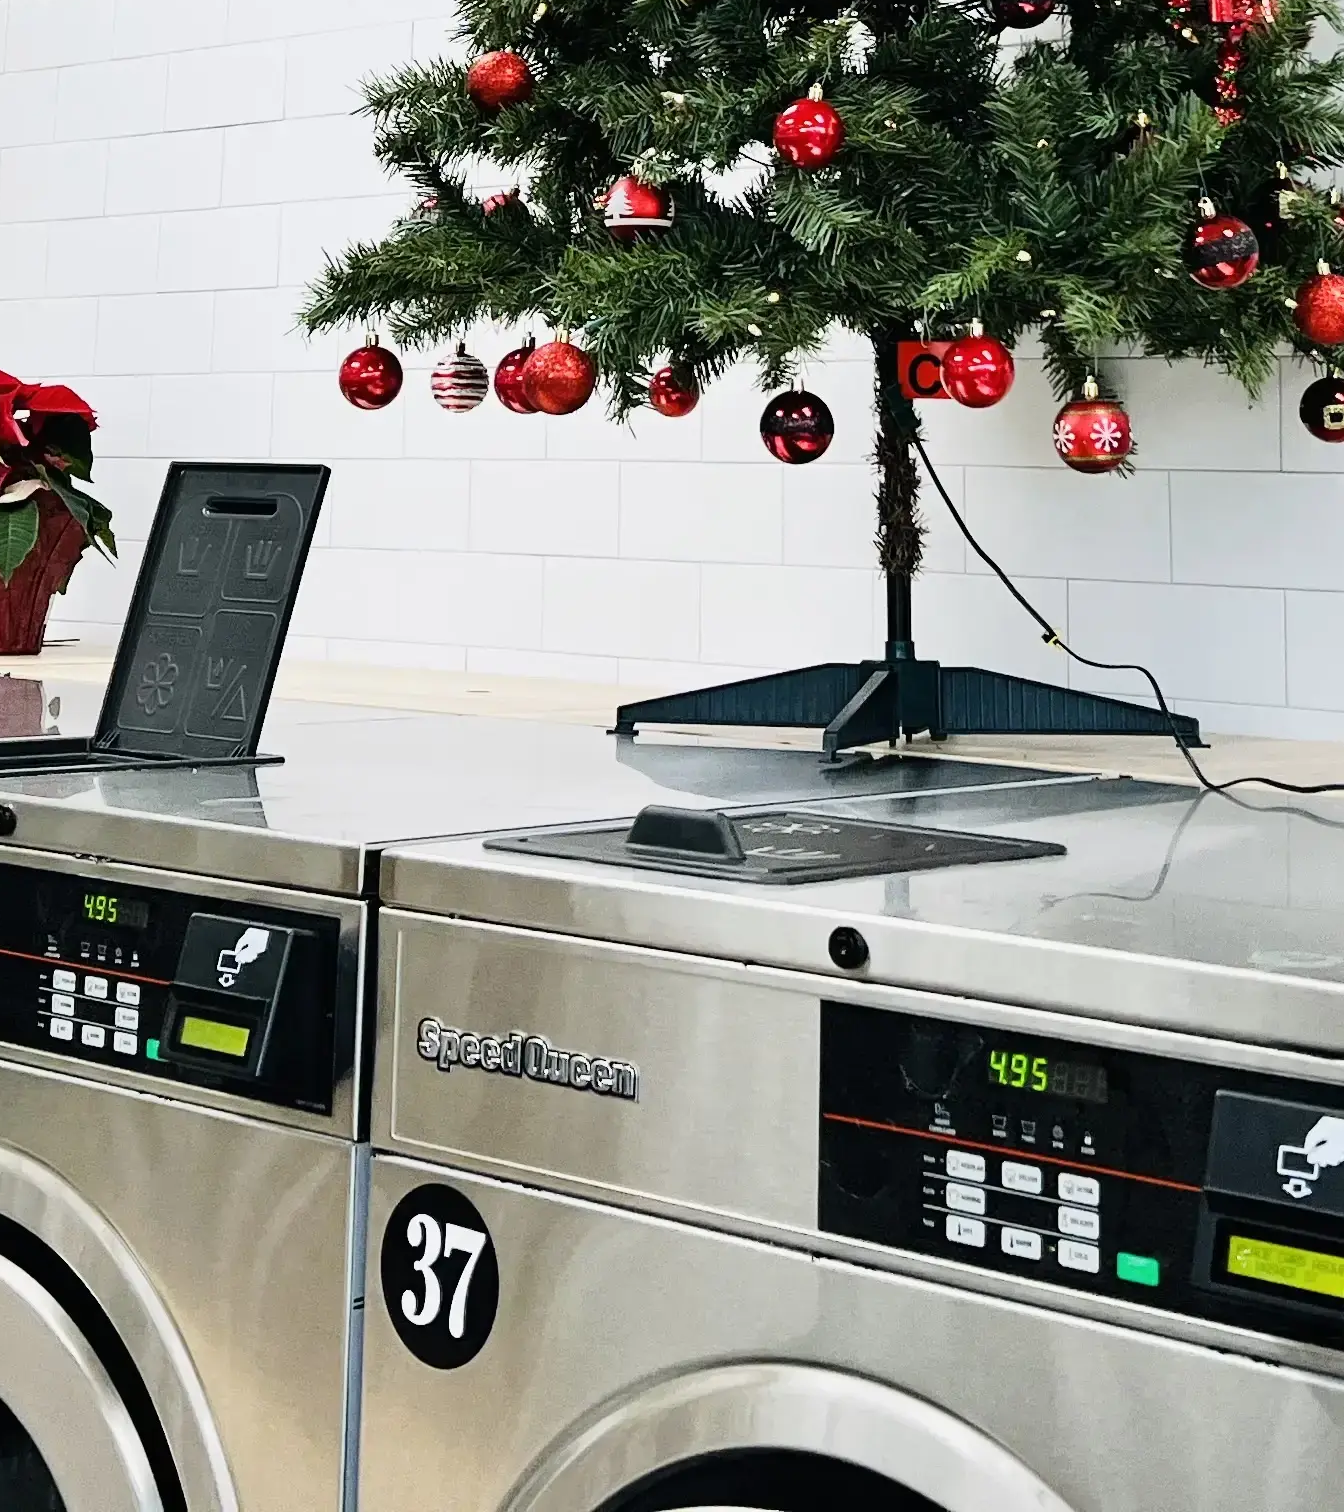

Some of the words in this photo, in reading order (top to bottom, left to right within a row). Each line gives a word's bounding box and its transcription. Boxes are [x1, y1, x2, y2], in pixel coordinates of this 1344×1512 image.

[417, 1017, 523, 1077] Speed
[523, 1035, 640, 1103] Queen
[402, 1214, 485, 1338] 37
